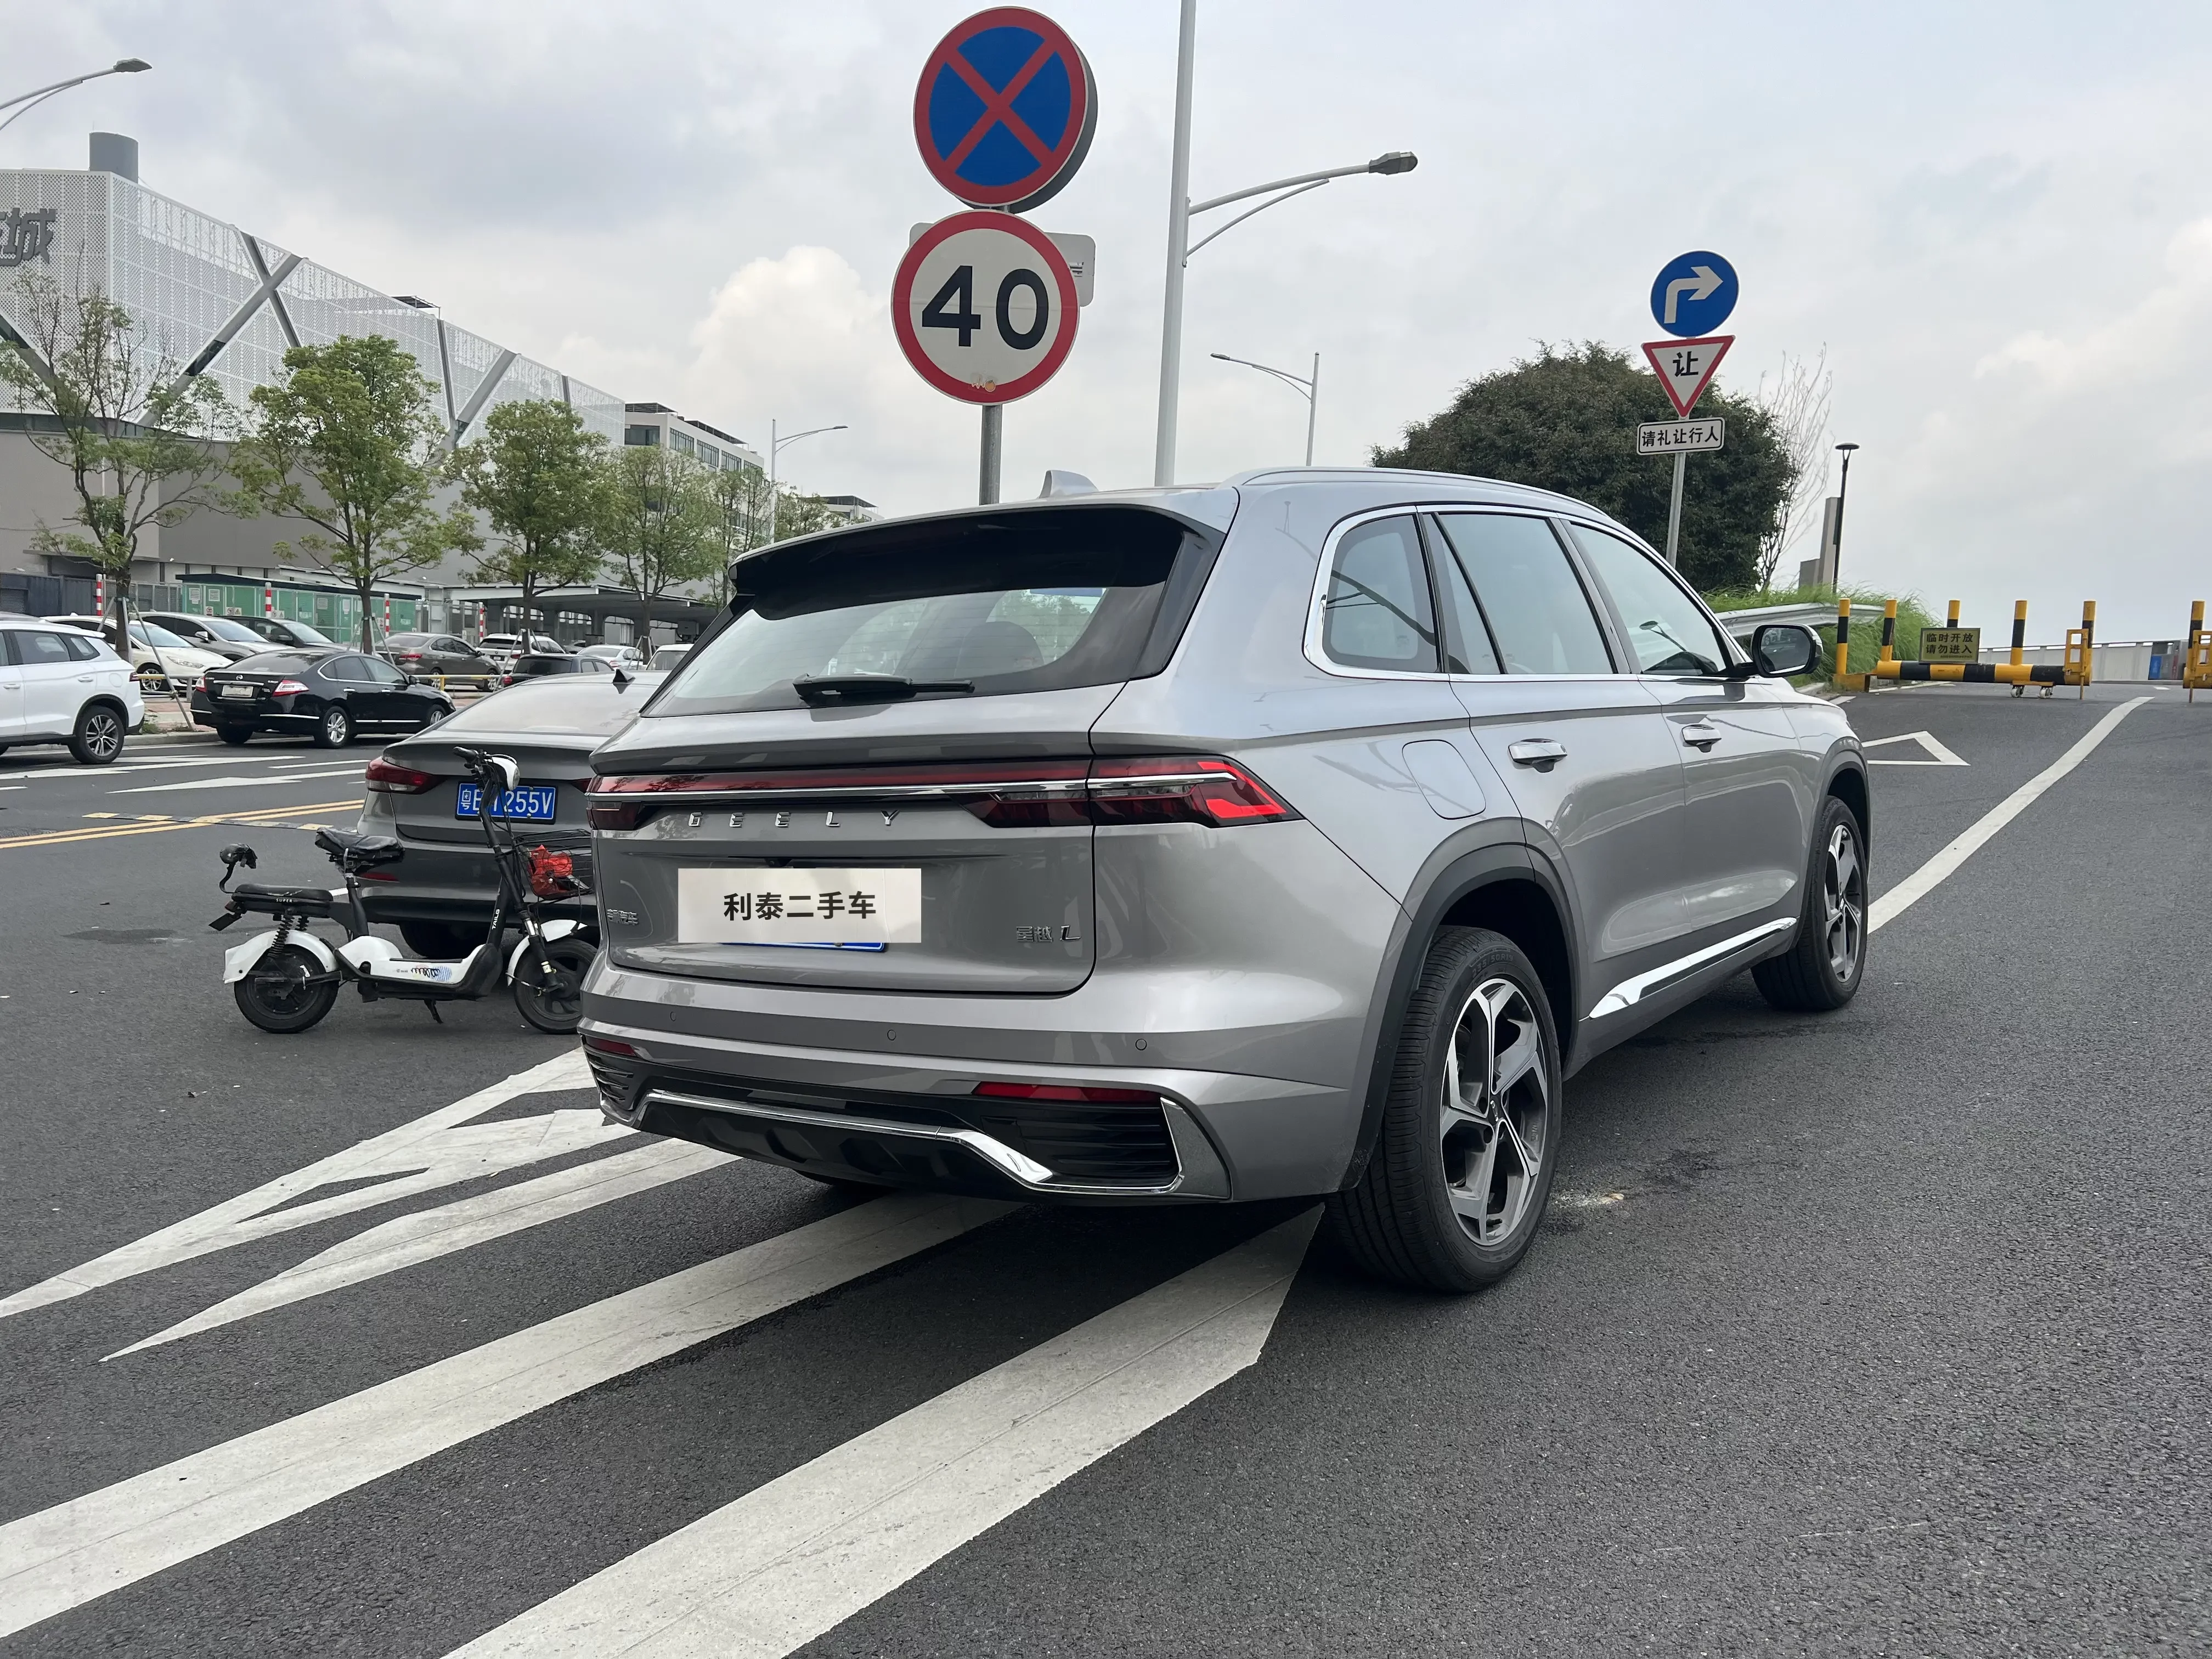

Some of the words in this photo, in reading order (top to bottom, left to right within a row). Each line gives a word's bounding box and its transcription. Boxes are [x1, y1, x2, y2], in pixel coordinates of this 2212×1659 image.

[0, 207, 56, 266] 城
[922, 266, 1049, 350] 40
[1673, 351, 1699, 377] 让
[1641, 426, 1719, 447] 请礼让行人
[1927, 633, 1974, 642] 临时开放
[1926, 644, 1973, 654] 请勿进入
[689, 811, 900, 827] GEELY
[1059, 925, 1081, 941] L
